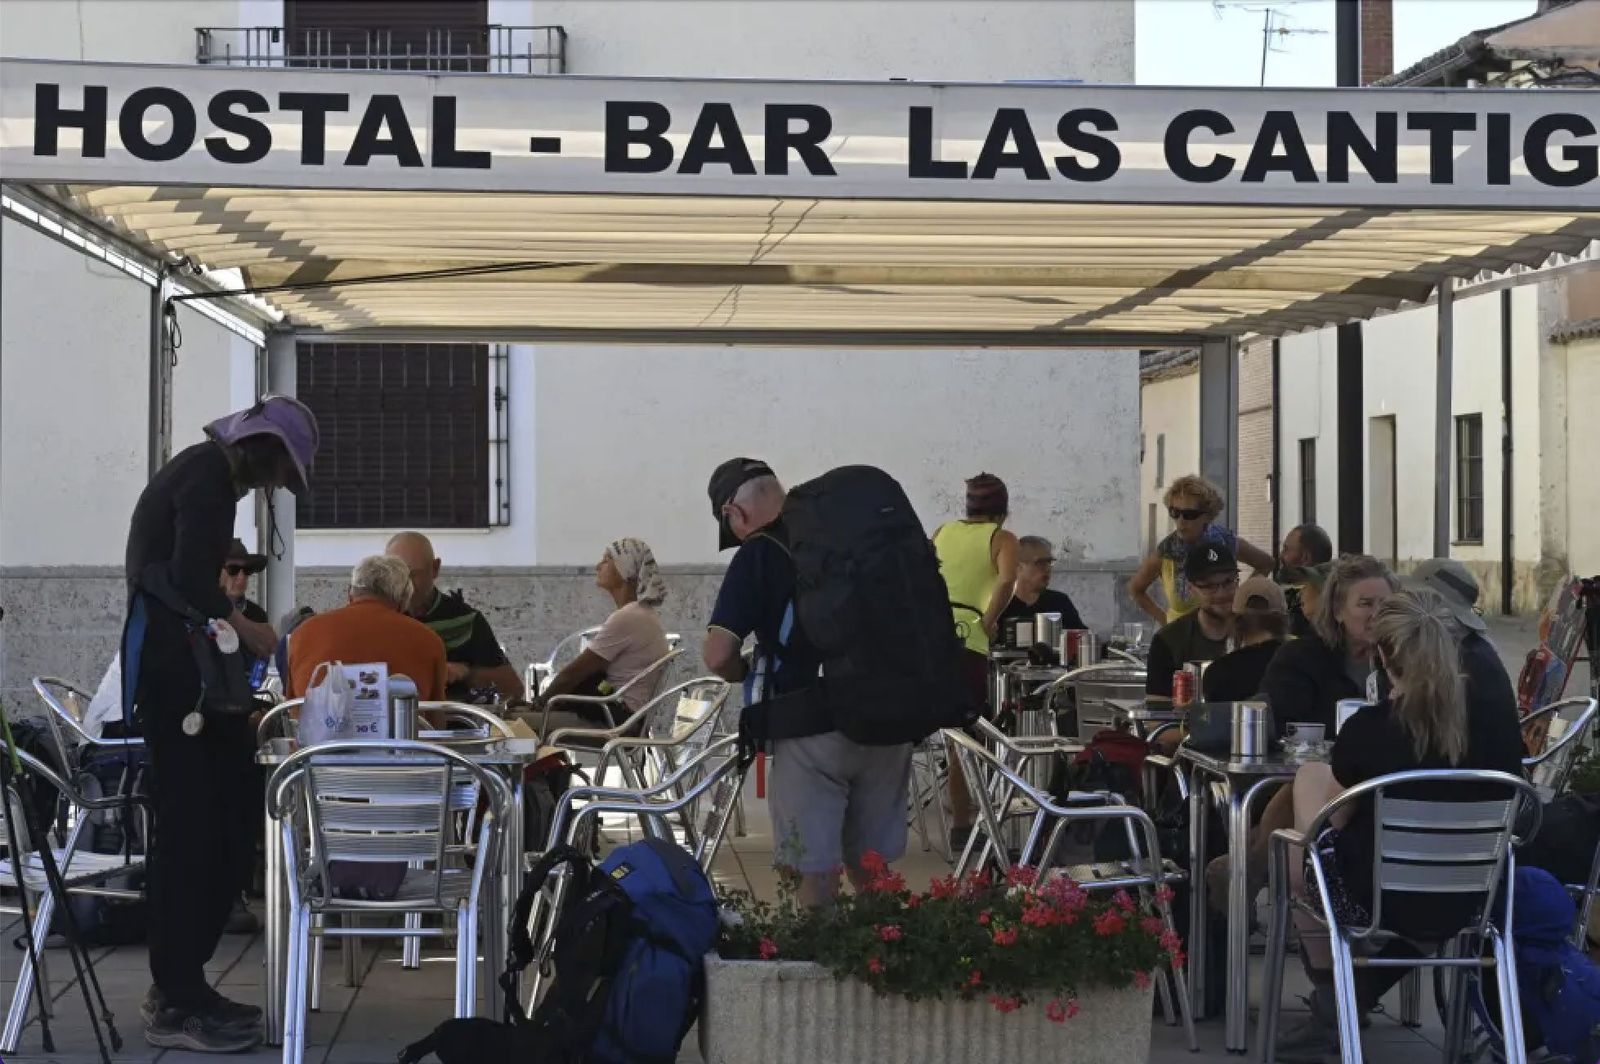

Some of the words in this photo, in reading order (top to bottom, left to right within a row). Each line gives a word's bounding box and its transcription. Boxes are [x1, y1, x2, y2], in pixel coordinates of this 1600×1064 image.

[34, 83, 492, 169] HOSTAL
[530, 136, 561, 153] -
[604, 101, 838, 176] BAR
[909, 106, 1122, 182] LAS
[1164, 109, 1599, 188] CANTIG
